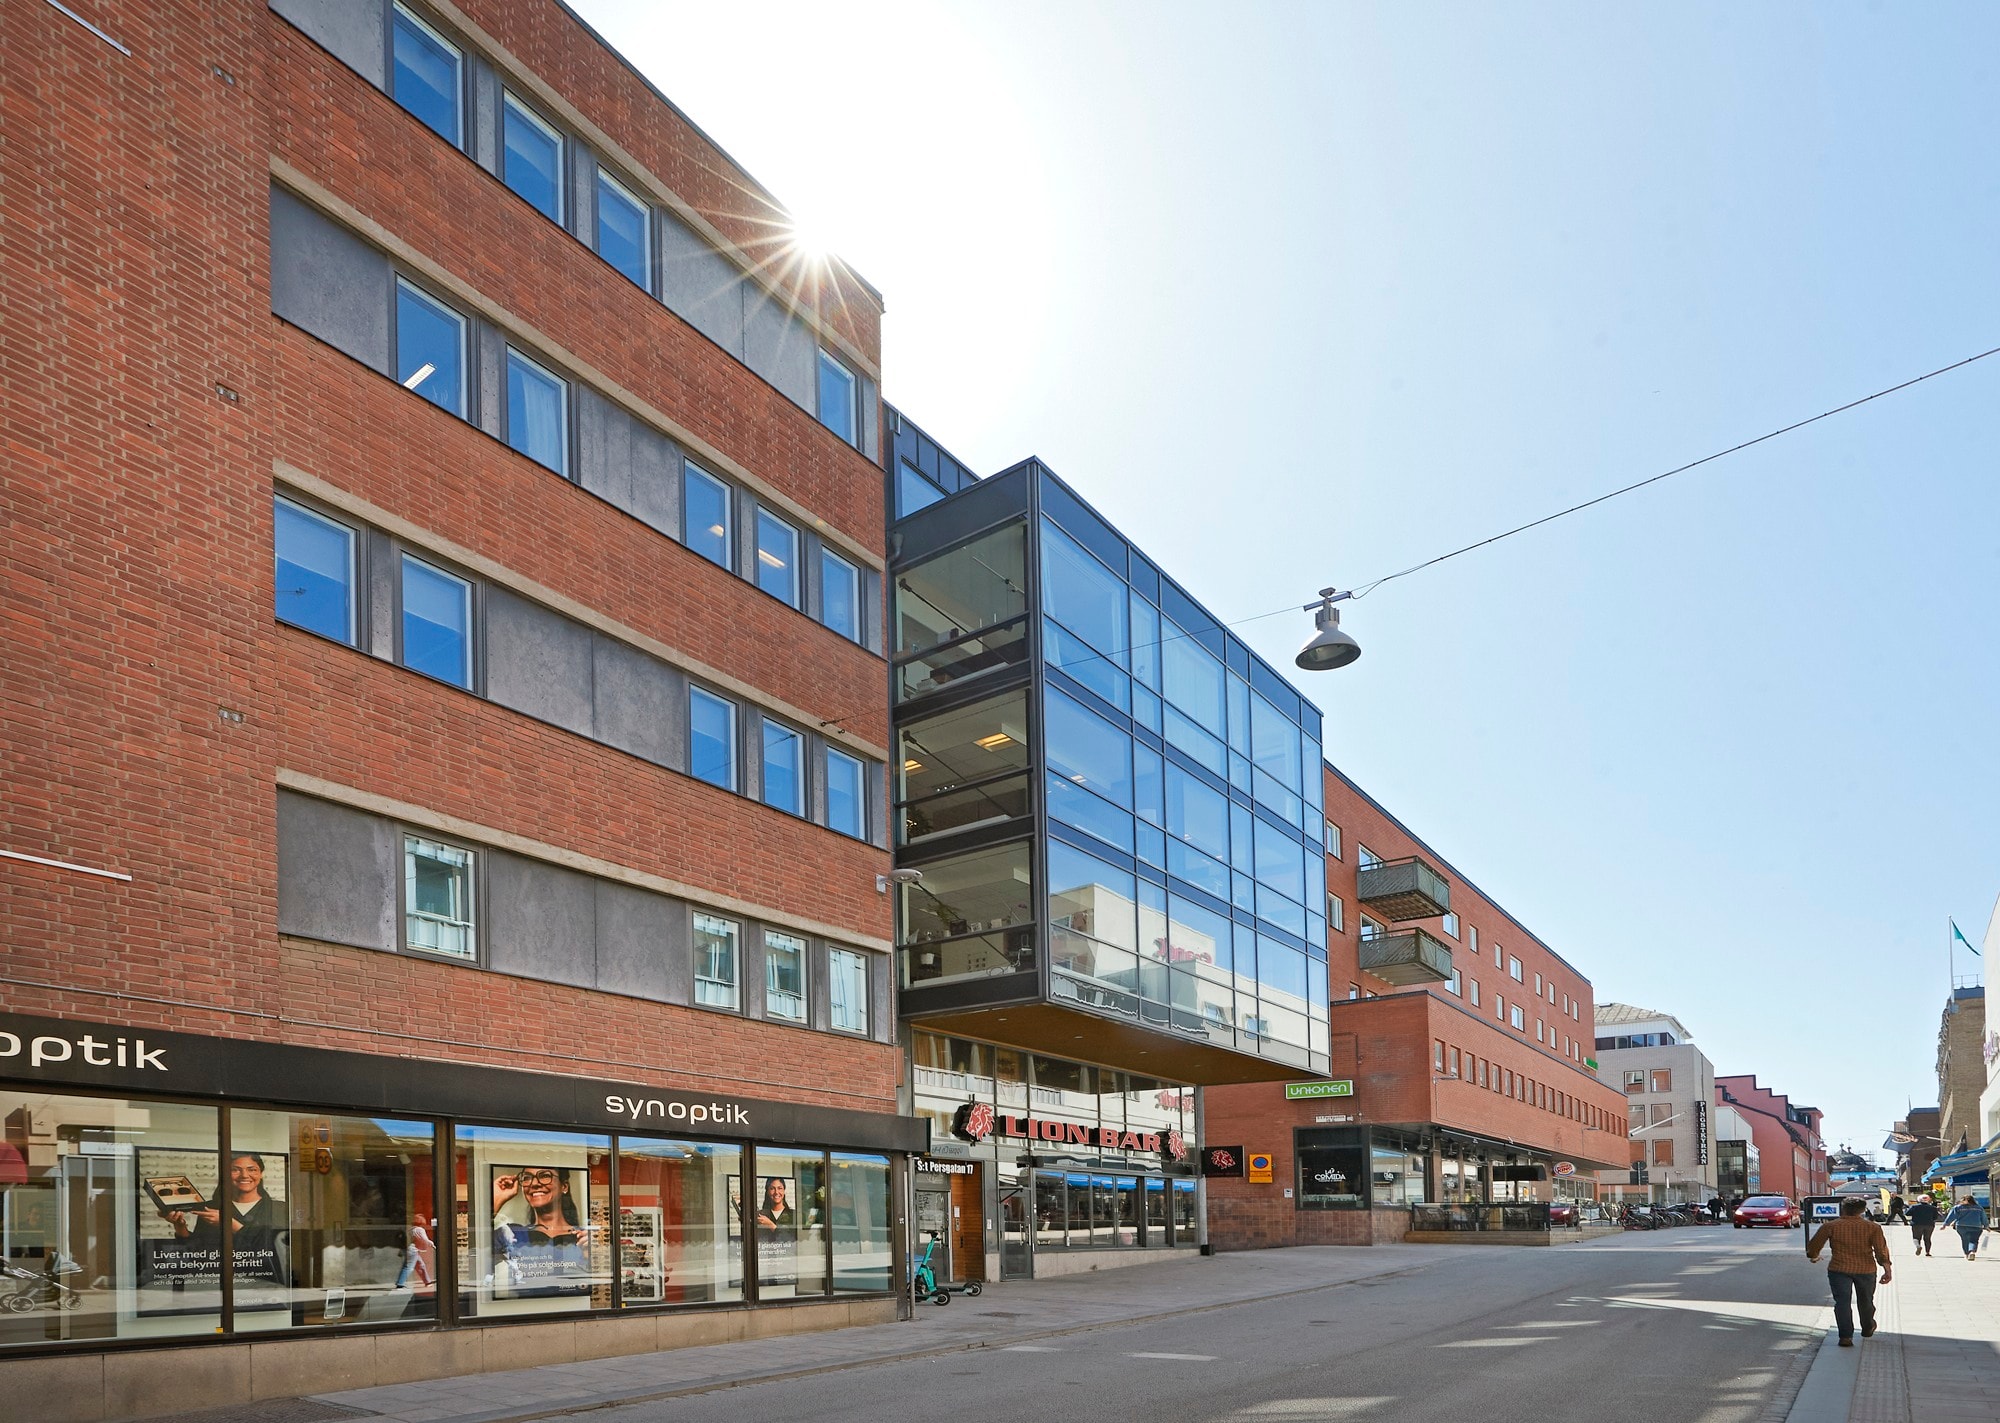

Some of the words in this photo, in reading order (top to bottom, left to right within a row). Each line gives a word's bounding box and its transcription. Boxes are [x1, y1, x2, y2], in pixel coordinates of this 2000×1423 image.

[605, 1095, 750, 1125] synoptik
[1005, 1115, 1089, 1144] LION
[1099, 1127, 1161, 1152] BAR
[1699, 1101, 1707, 1165] PINGSTKYRKAN
[153, 1250, 180, 1259] Livet
[182, 1249, 207, 1259] med
[209, 1249, 254, 1260] glgon
[256, 1248, 273, 1257] ska
[153, 1261, 177, 1269] vara
[180, 1259, 263, 1270] bekymrsfritt!
